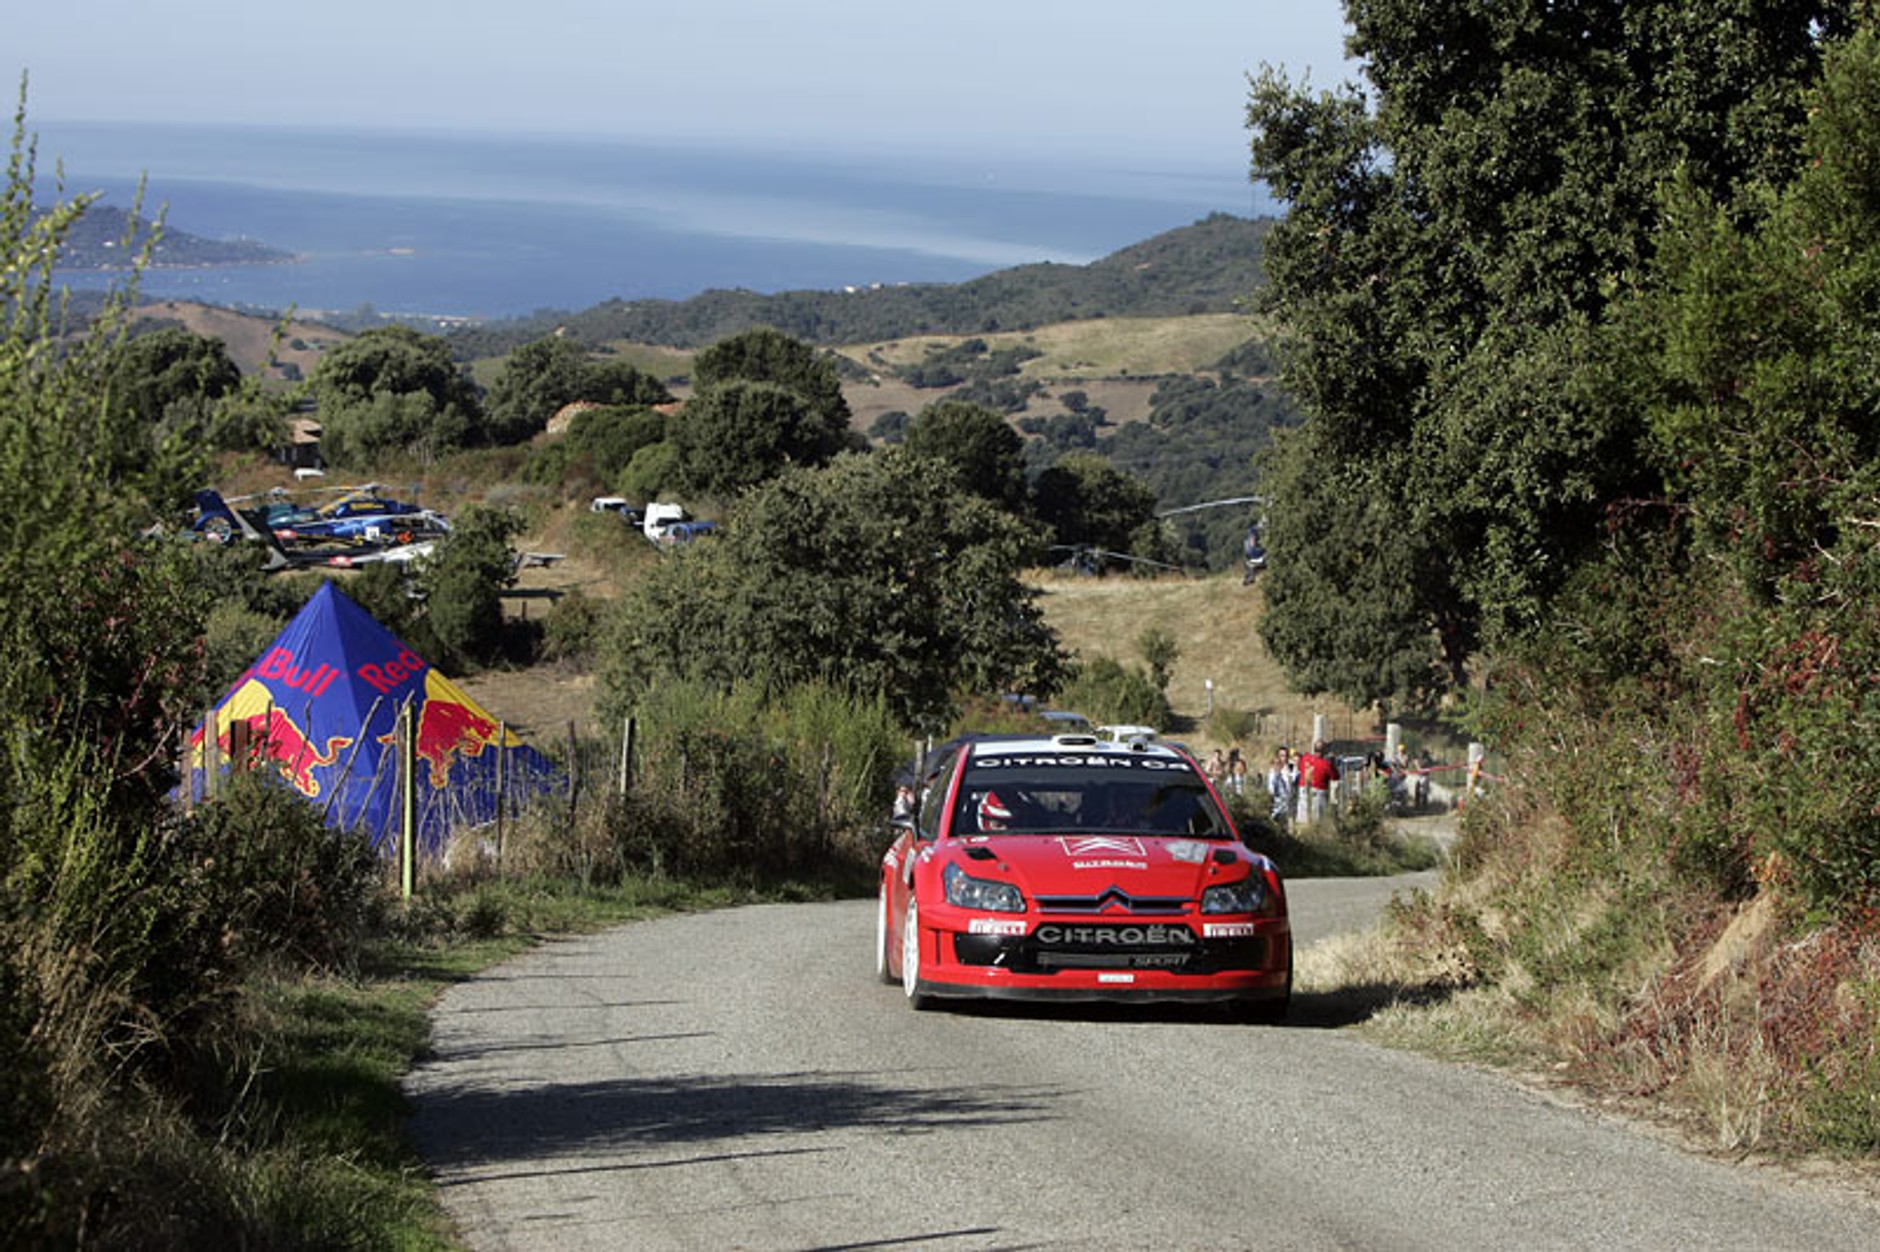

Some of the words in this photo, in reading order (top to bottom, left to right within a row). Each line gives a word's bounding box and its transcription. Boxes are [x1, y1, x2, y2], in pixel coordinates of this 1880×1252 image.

[256, 646, 340, 697] Bull
[356, 640, 425, 694] Red
[1036, 924, 1194, 944] CITROËN
